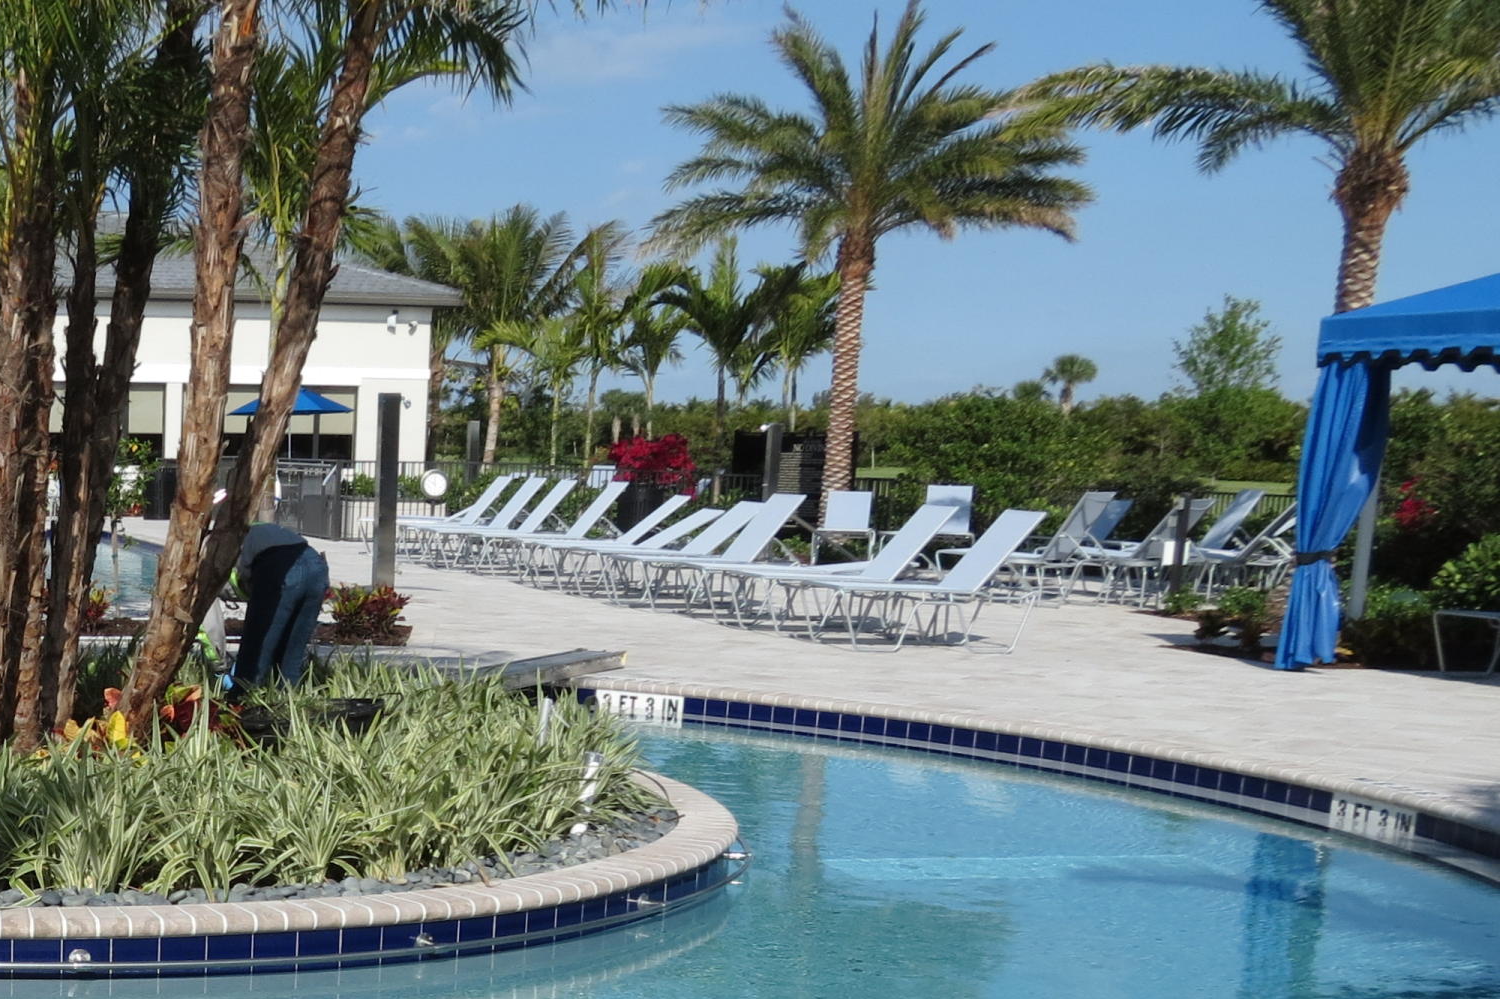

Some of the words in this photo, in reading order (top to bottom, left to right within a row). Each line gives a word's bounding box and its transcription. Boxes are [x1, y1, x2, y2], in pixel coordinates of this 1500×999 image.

[619, 695, 638, 716] FT
[662, 698, 679, 719] IN
[1337, 800, 1347, 817] 3
[1353, 803, 1372, 822] FT
[1378, 809, 1389, 827] 3
[1394, 812, 1412, 832] IN
